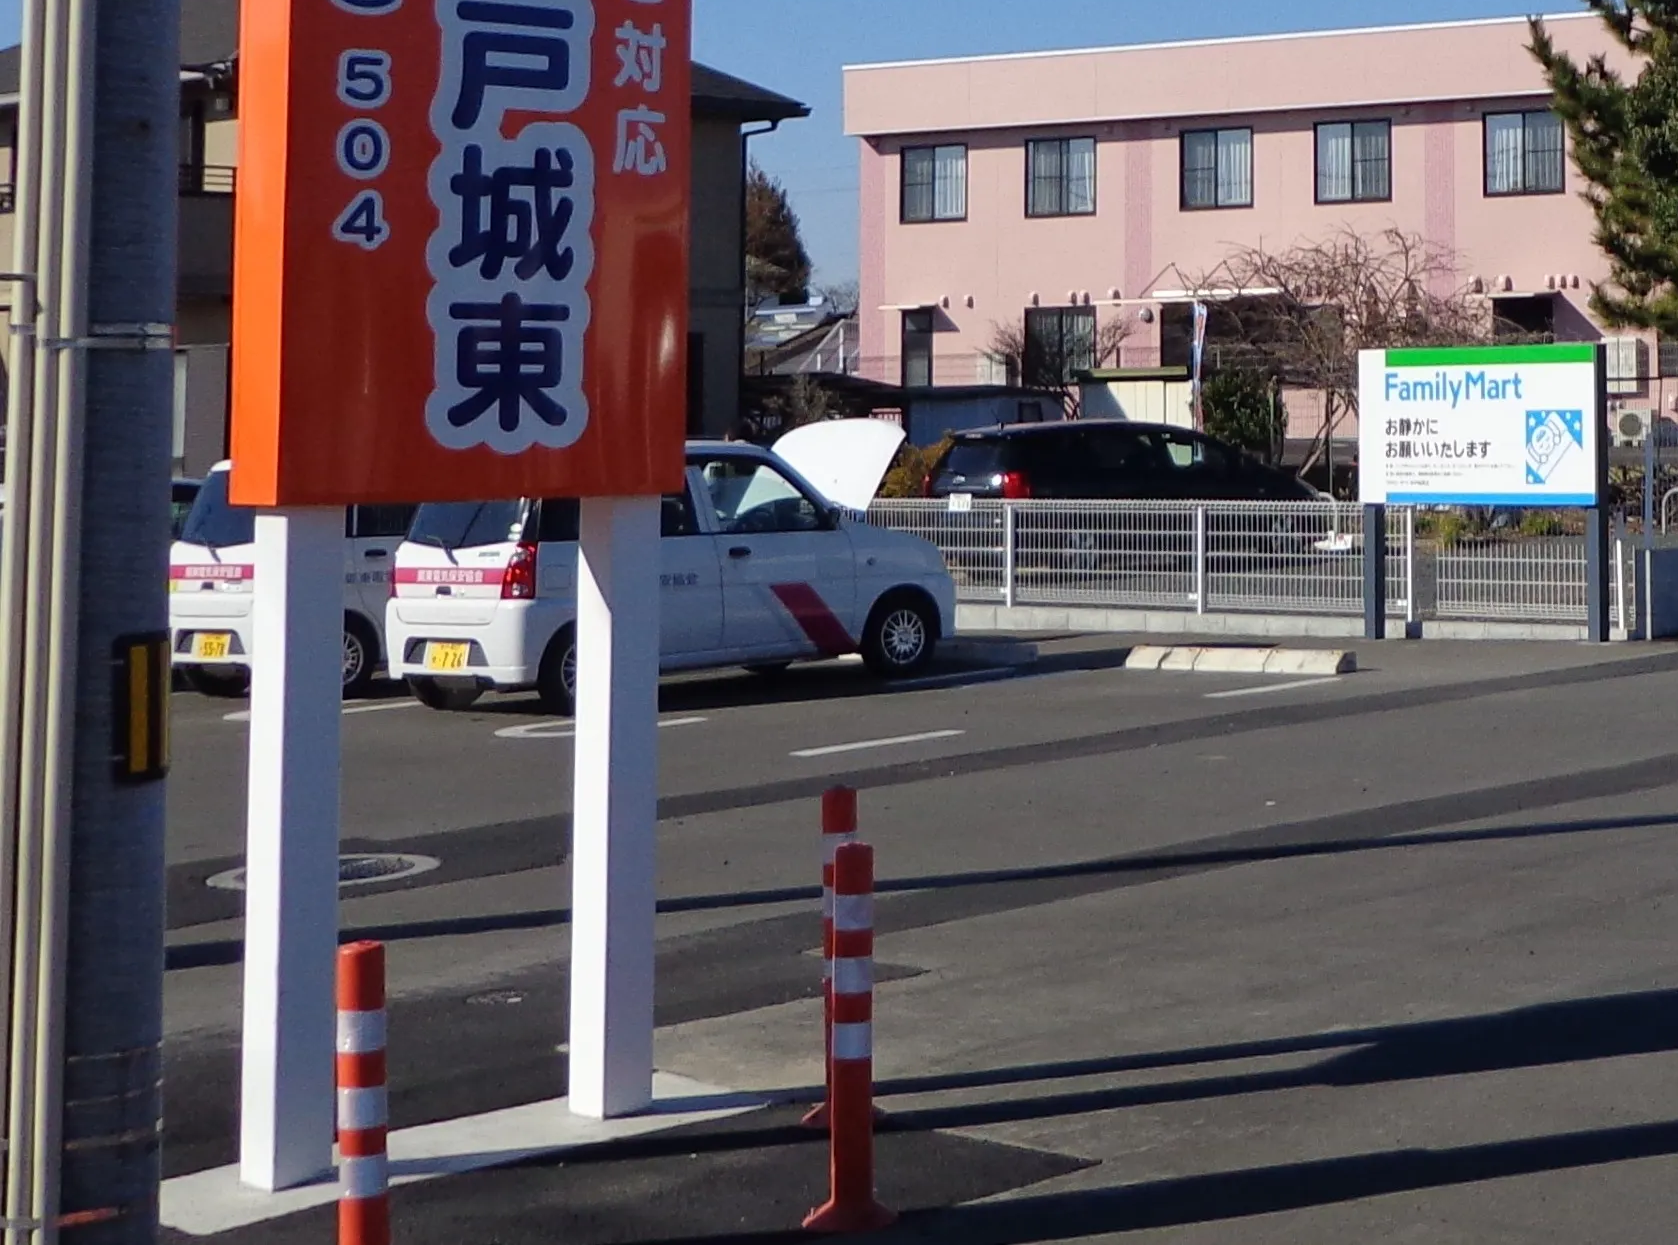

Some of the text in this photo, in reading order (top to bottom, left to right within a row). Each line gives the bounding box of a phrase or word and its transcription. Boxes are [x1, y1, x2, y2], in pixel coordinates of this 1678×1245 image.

[1384, 370, 1523, 409] FamilyMart
[1385, 417, 1439, 437] お静かに
[1385, 439, 1492, 459] お願いいたします
